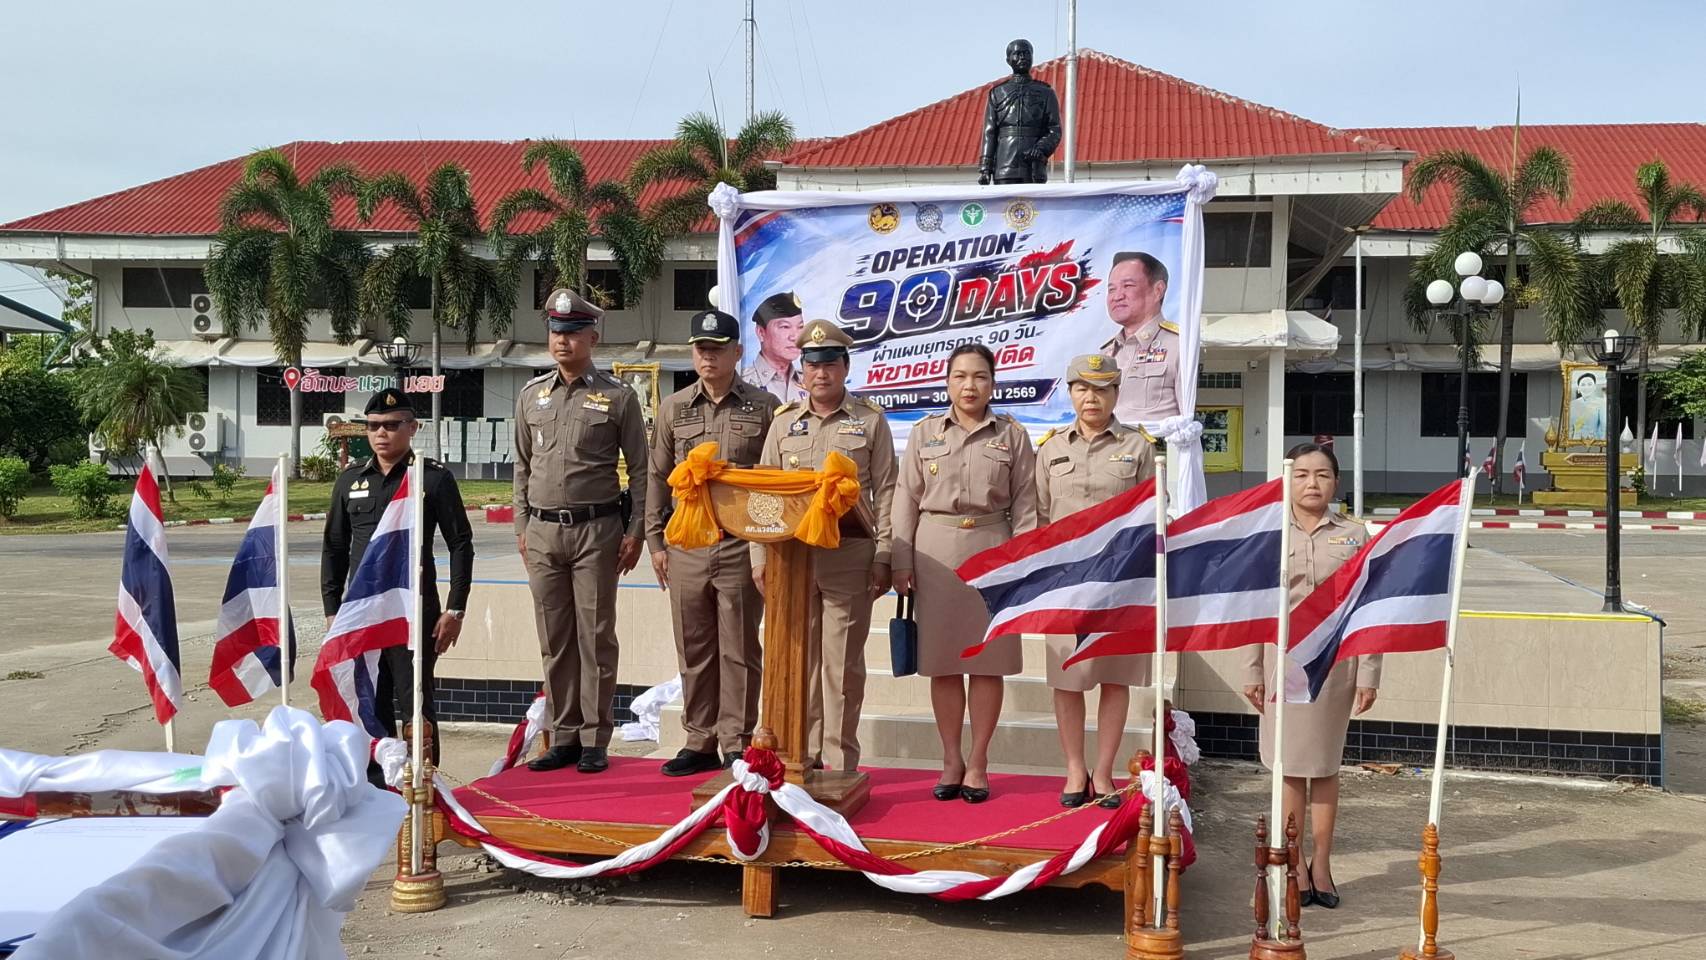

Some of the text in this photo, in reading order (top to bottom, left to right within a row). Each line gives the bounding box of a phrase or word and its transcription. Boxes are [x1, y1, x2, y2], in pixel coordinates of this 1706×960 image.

[871, 232, 1017, 274] OPERATION
[836, 262, 1080, 344] 90 DAYS
[987, 329, 1010, 345] 90
[1013, 324, 1036, 340] วัน
[932, 391, 948, 402] 30
[1005, 386, 1036, 399] 2569
